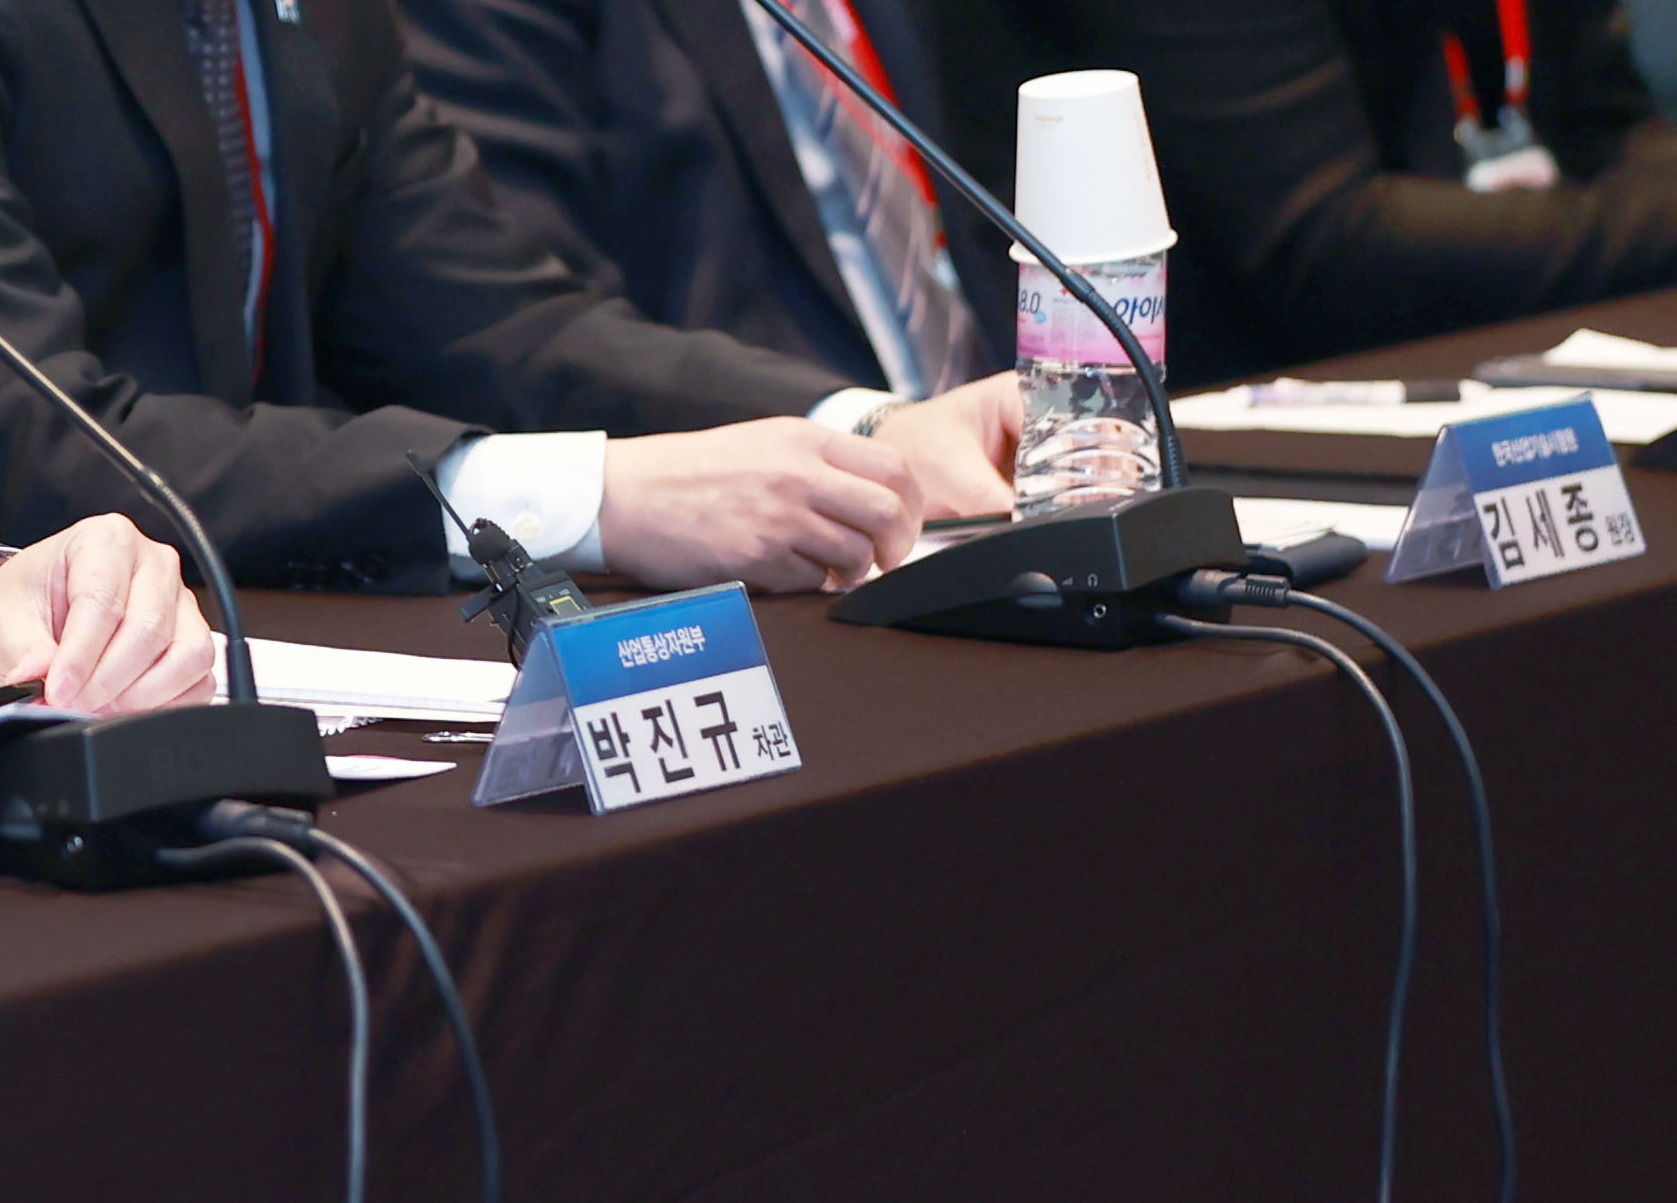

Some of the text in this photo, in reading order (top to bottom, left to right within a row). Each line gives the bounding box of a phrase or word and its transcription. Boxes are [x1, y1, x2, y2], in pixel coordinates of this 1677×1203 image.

[1483, 482, 1599, 570] 김세종
[617, 625, 707, 669] 산업통상자원부
[586, 691, 792, 794] 박진규 차관
